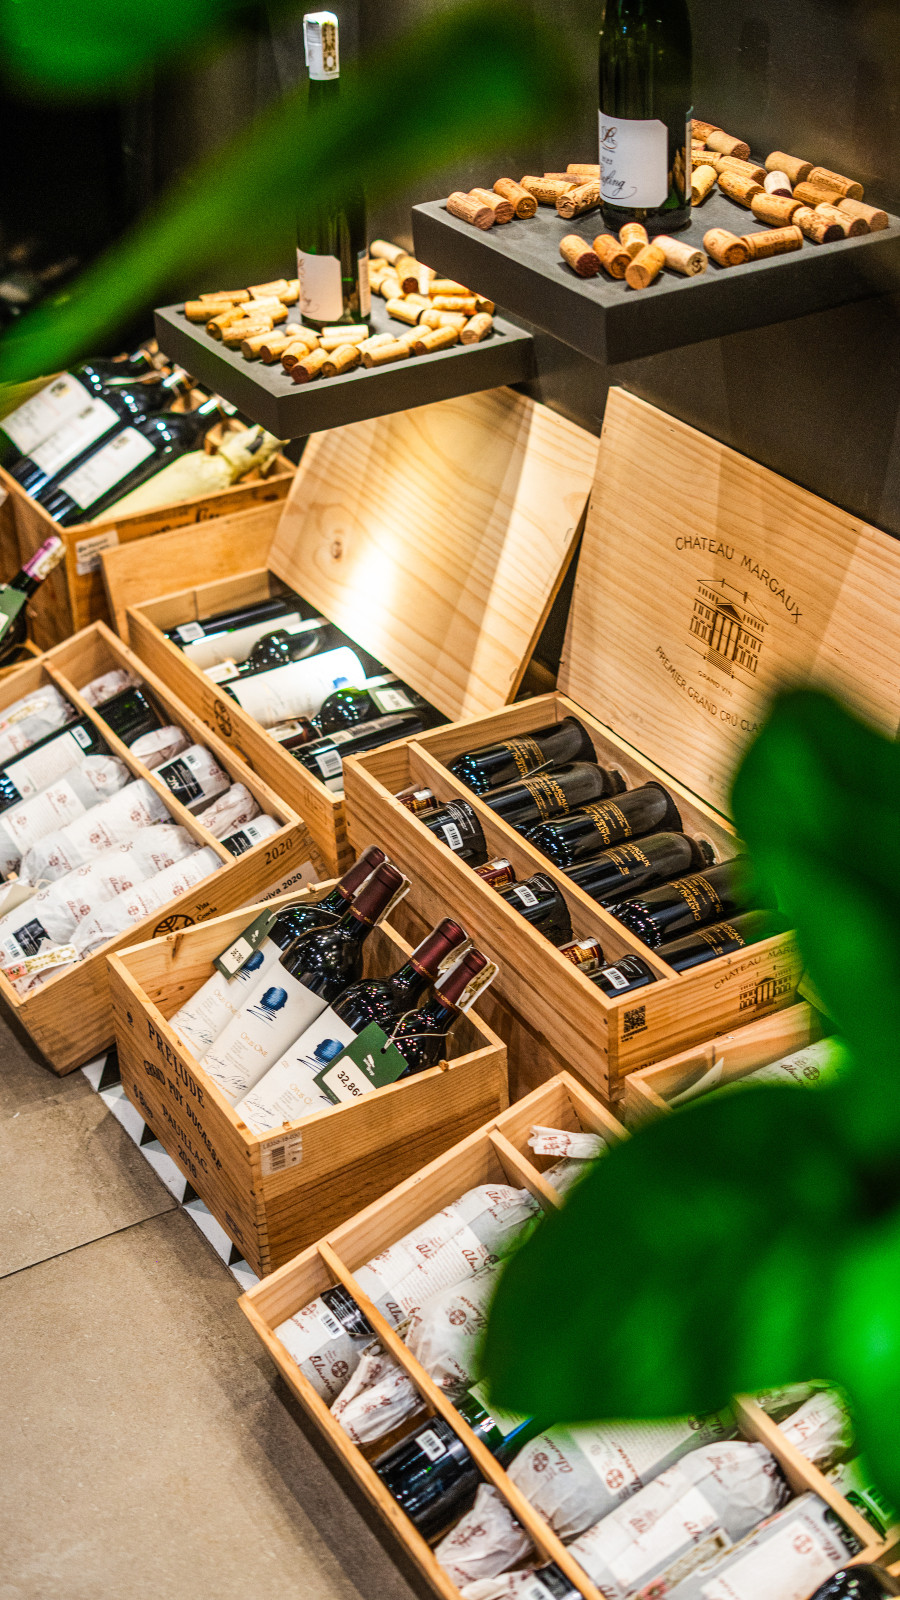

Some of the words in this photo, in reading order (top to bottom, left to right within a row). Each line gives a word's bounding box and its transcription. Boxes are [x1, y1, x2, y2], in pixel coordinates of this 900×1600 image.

[528, 186, 557, 197] GRAVES
[740, 555, 802, 624] MARGAUX
[655, 645, 687, 692] PREMIER
[687, 686, 717, 715] GRAND
[264, 838, 293, 865] 2020
[281, 872, 303, 890] 2020
[146, 1018, 205, 1109] PRELUDE
[327, 1071, 364, 1097] 32,86
[161, 1103, 209, 1174] PAUILLAC
[167, 1077, 184, 1107] PUY
[186, 1101, 223, 1171] DUCASSE
